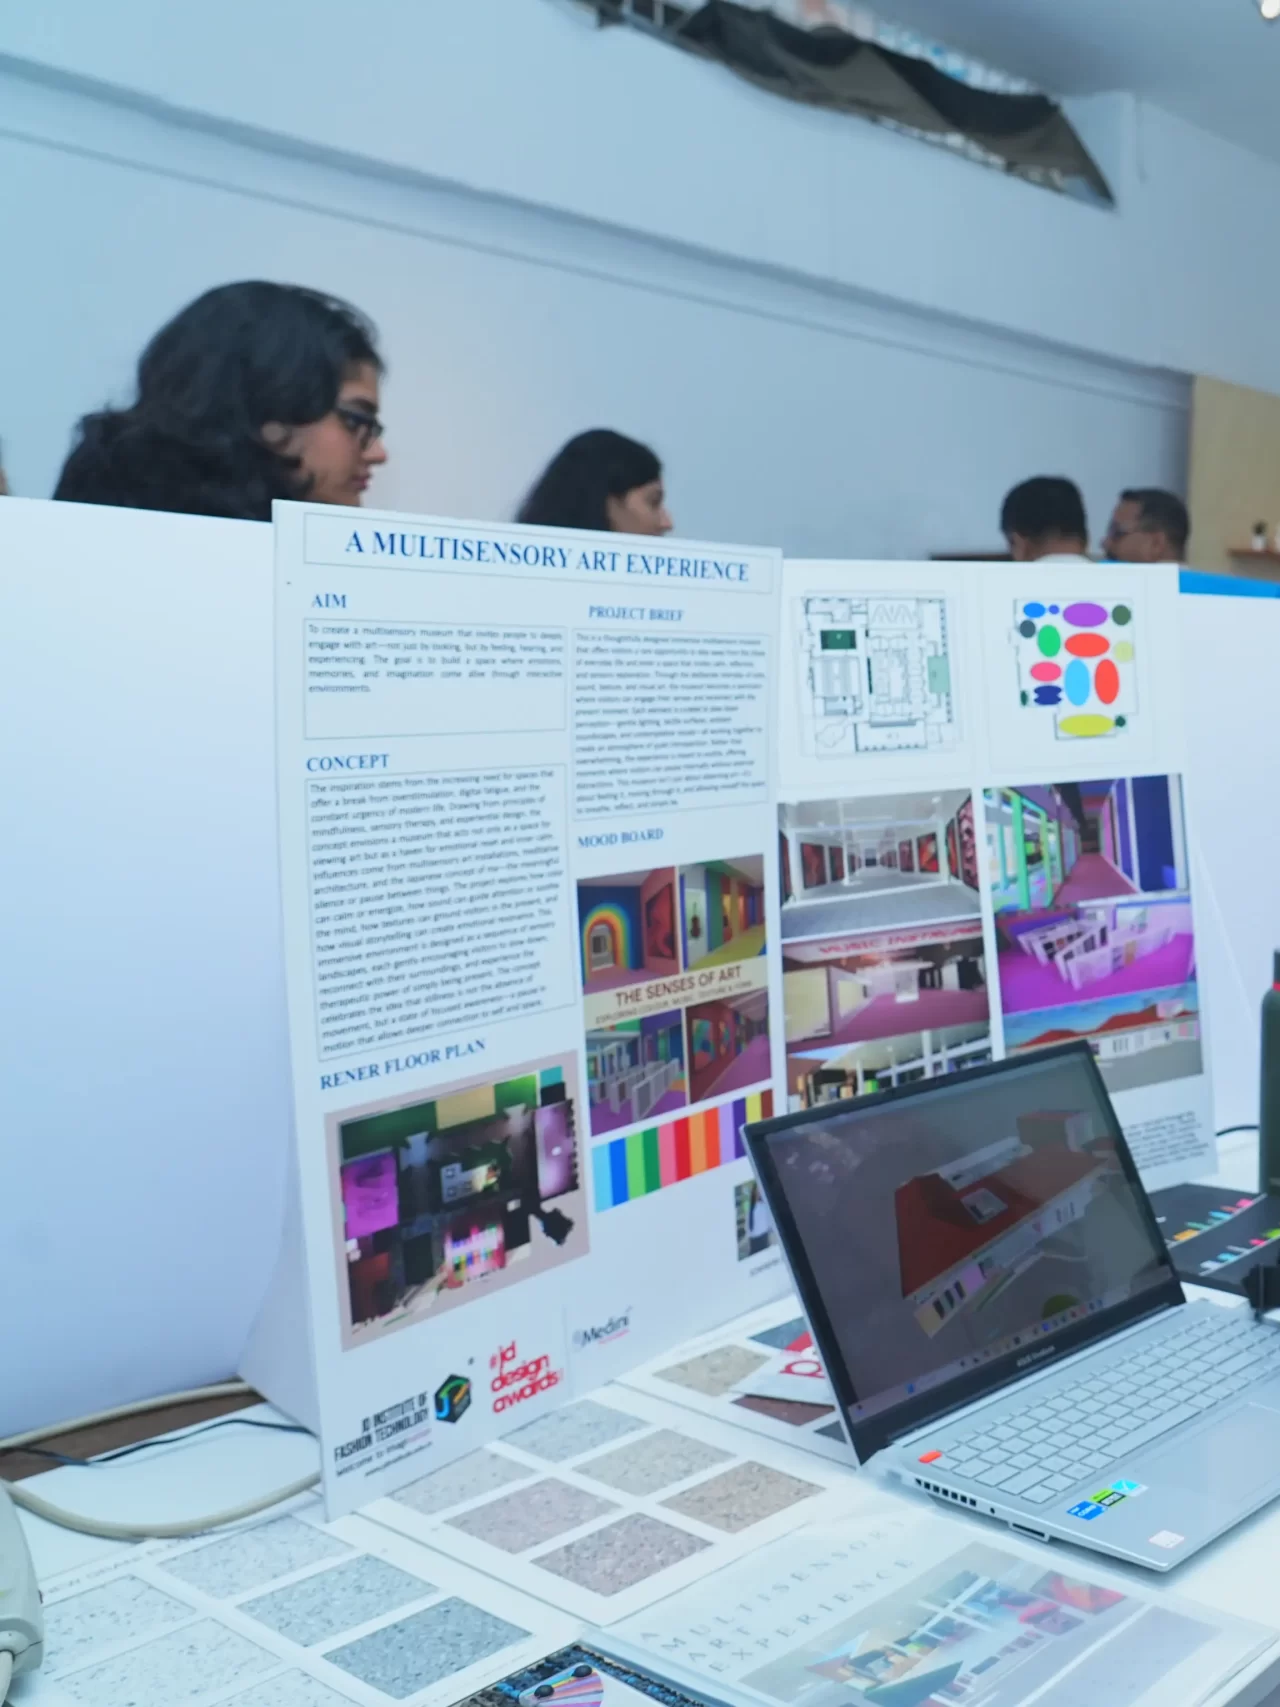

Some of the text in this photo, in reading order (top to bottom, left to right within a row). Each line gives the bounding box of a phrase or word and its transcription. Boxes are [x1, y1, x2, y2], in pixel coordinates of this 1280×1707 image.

[346, 530, 751, 583] A MULTISENSORY ART EXPERIENCE
[311, 593, 348, 610] AIM
[588, 605, 684, 623] PROJECT BRIEF
[321, 624, 350, 634] create
[307, 640, 340, 650] engage
[306, 754, 390, 773] CONCEPT
[309, 782, 327, 792] The
[310, 796, 331, 807] offer
[310, 810, 349, 822] constant
[577, 827, 664, 848] MOOD BOARD
[310, 839, 348, 853] concept
[312, 852, 347, 867] viewing
[313, 896, 345, 909] silence
[314, 914, 331, 923] can
[314, 926, 331, 937] the
[315, 940, 336, 952] how
[316, 950, 363, 966] immersive
[318, 979, 363, 995] reconnect
[616, 964, 742, 1007] THE SENSES OF ART
[320, 1005, 366, 1023] celebrates
[322, 1036, 355, 1052] motion
[320, 1038, 486, 1090] RENER FLOOR PLAN
[491, 1353, 549, 1392] design
[493, 1371, 559, 1413] awards
[373, 1396, 415, 1428] INSTITUTE
[418, 1391, 427, 1407] OF
[334, 1432, 373, 1461] FASHION
[375, 1407, 429, 1442] TECHNOLOGY
[707, 1557, 915, 1673] EXPERIENCE
[687, 1624, 751, 1663] ART
